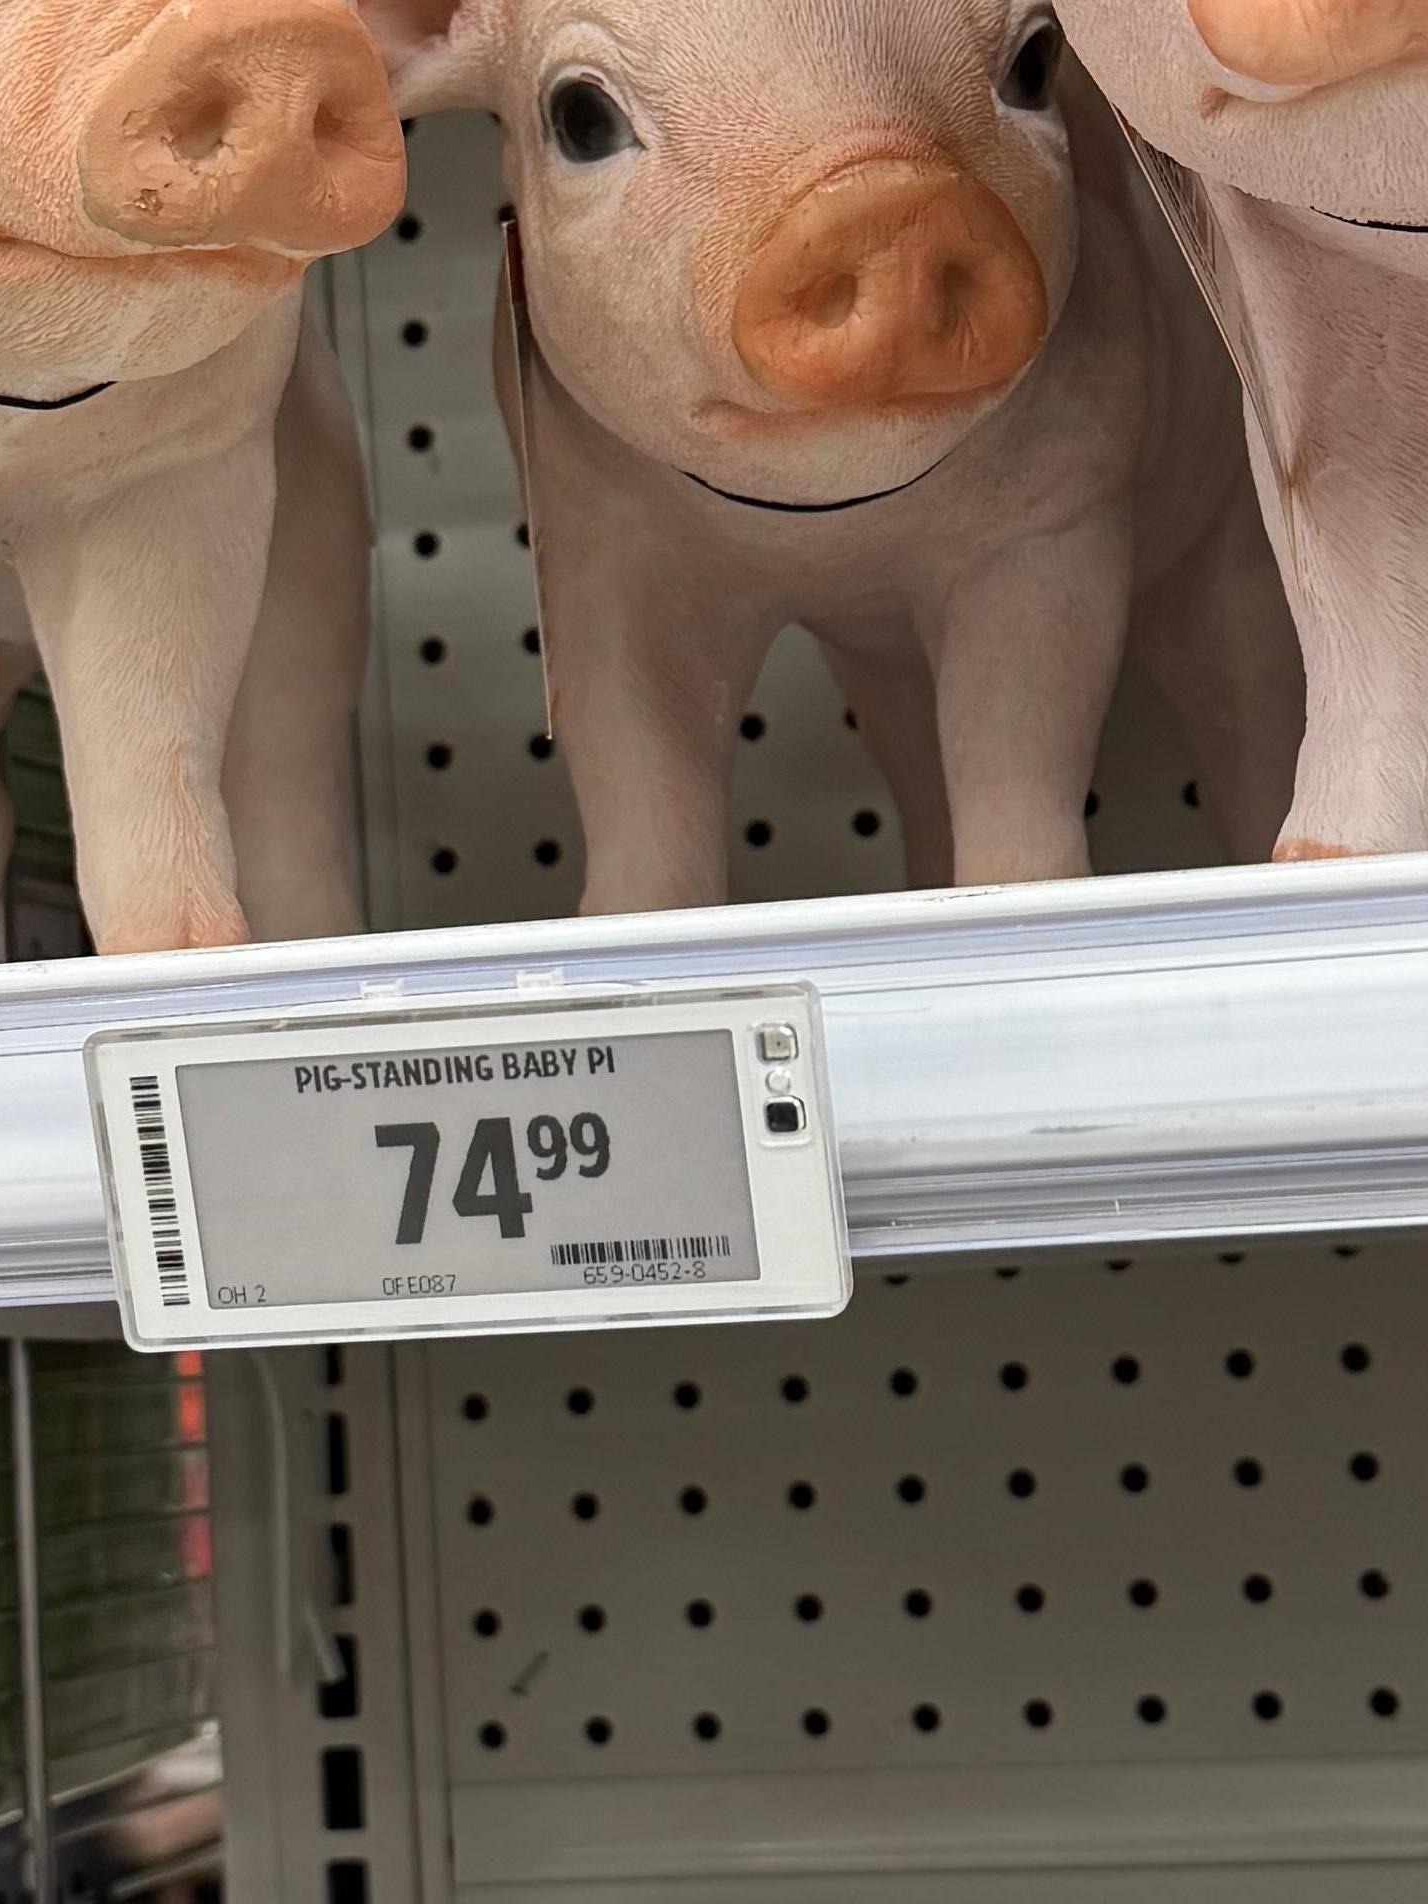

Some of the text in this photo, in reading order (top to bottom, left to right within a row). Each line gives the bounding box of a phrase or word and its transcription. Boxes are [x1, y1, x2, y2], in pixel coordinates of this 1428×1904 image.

[295, 1045, 616, 1094] PIG-STANDING BABY PI
[583, 1261, 708, 1286] 659-0452-8
[217, 1284, 267, 1305] OH 2
